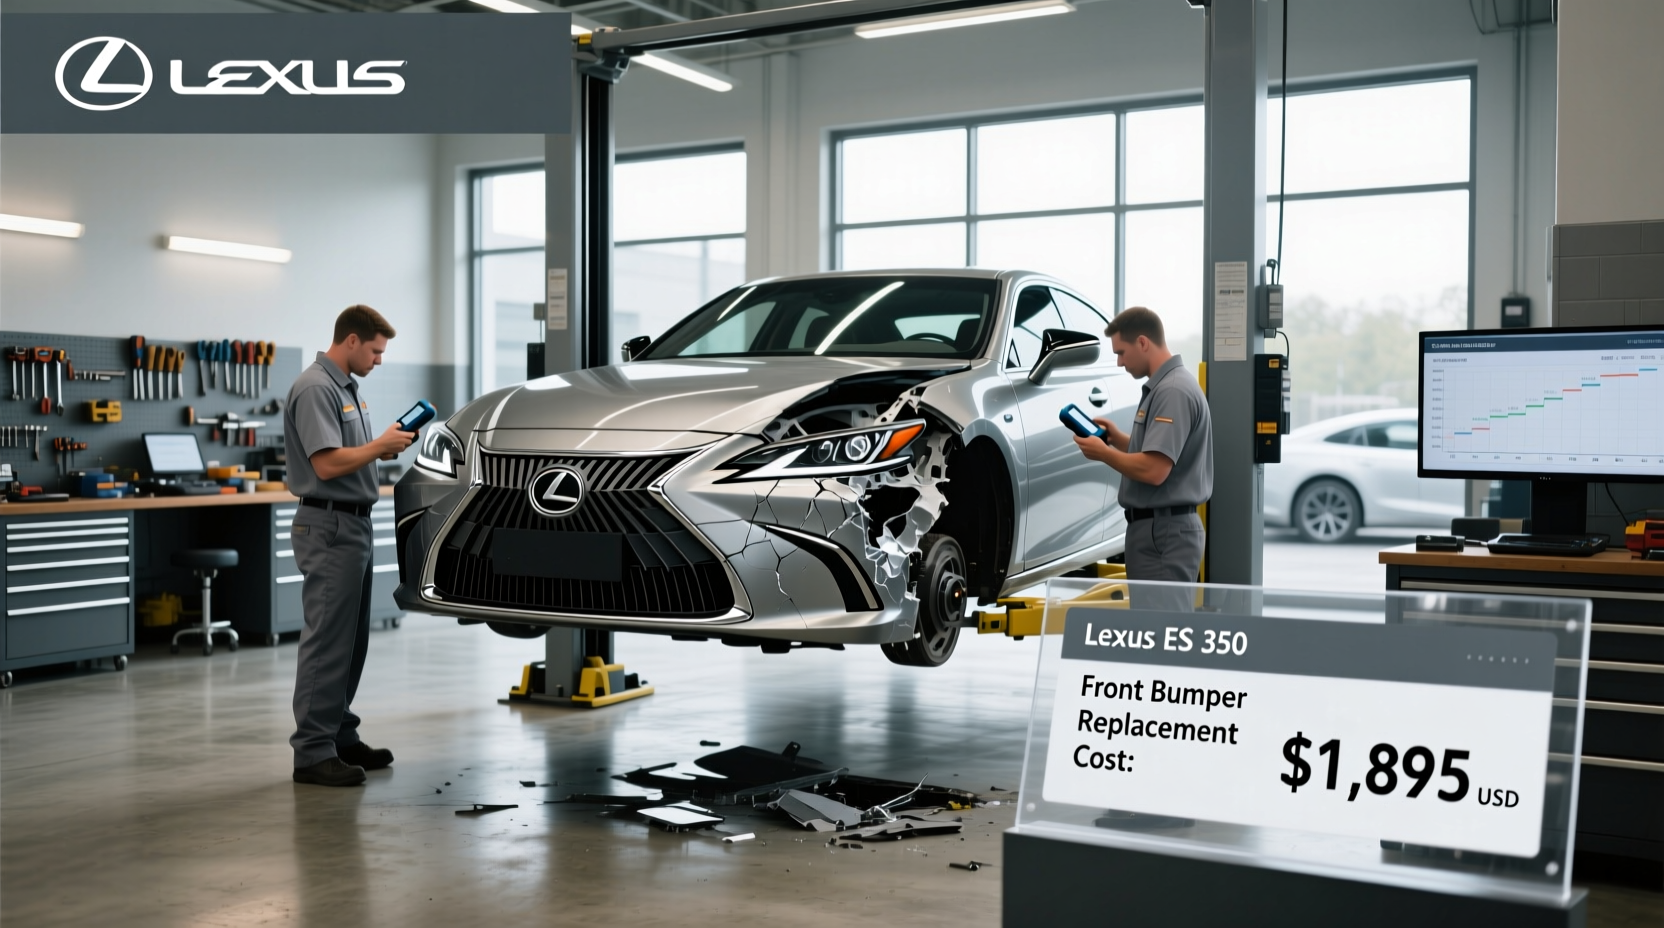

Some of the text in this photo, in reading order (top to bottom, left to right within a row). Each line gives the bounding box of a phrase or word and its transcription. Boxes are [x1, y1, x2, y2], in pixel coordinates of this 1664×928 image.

[1084, 622, 1248, 656] Lexus ES 350
[1081, 674, 1248, 713] Front Bumper
[1077, 709, 1239, 745] Replacement
[1073, 744, 1135, 773] Cost:
[1280, 731, 1520, 808] $1,895 USD
